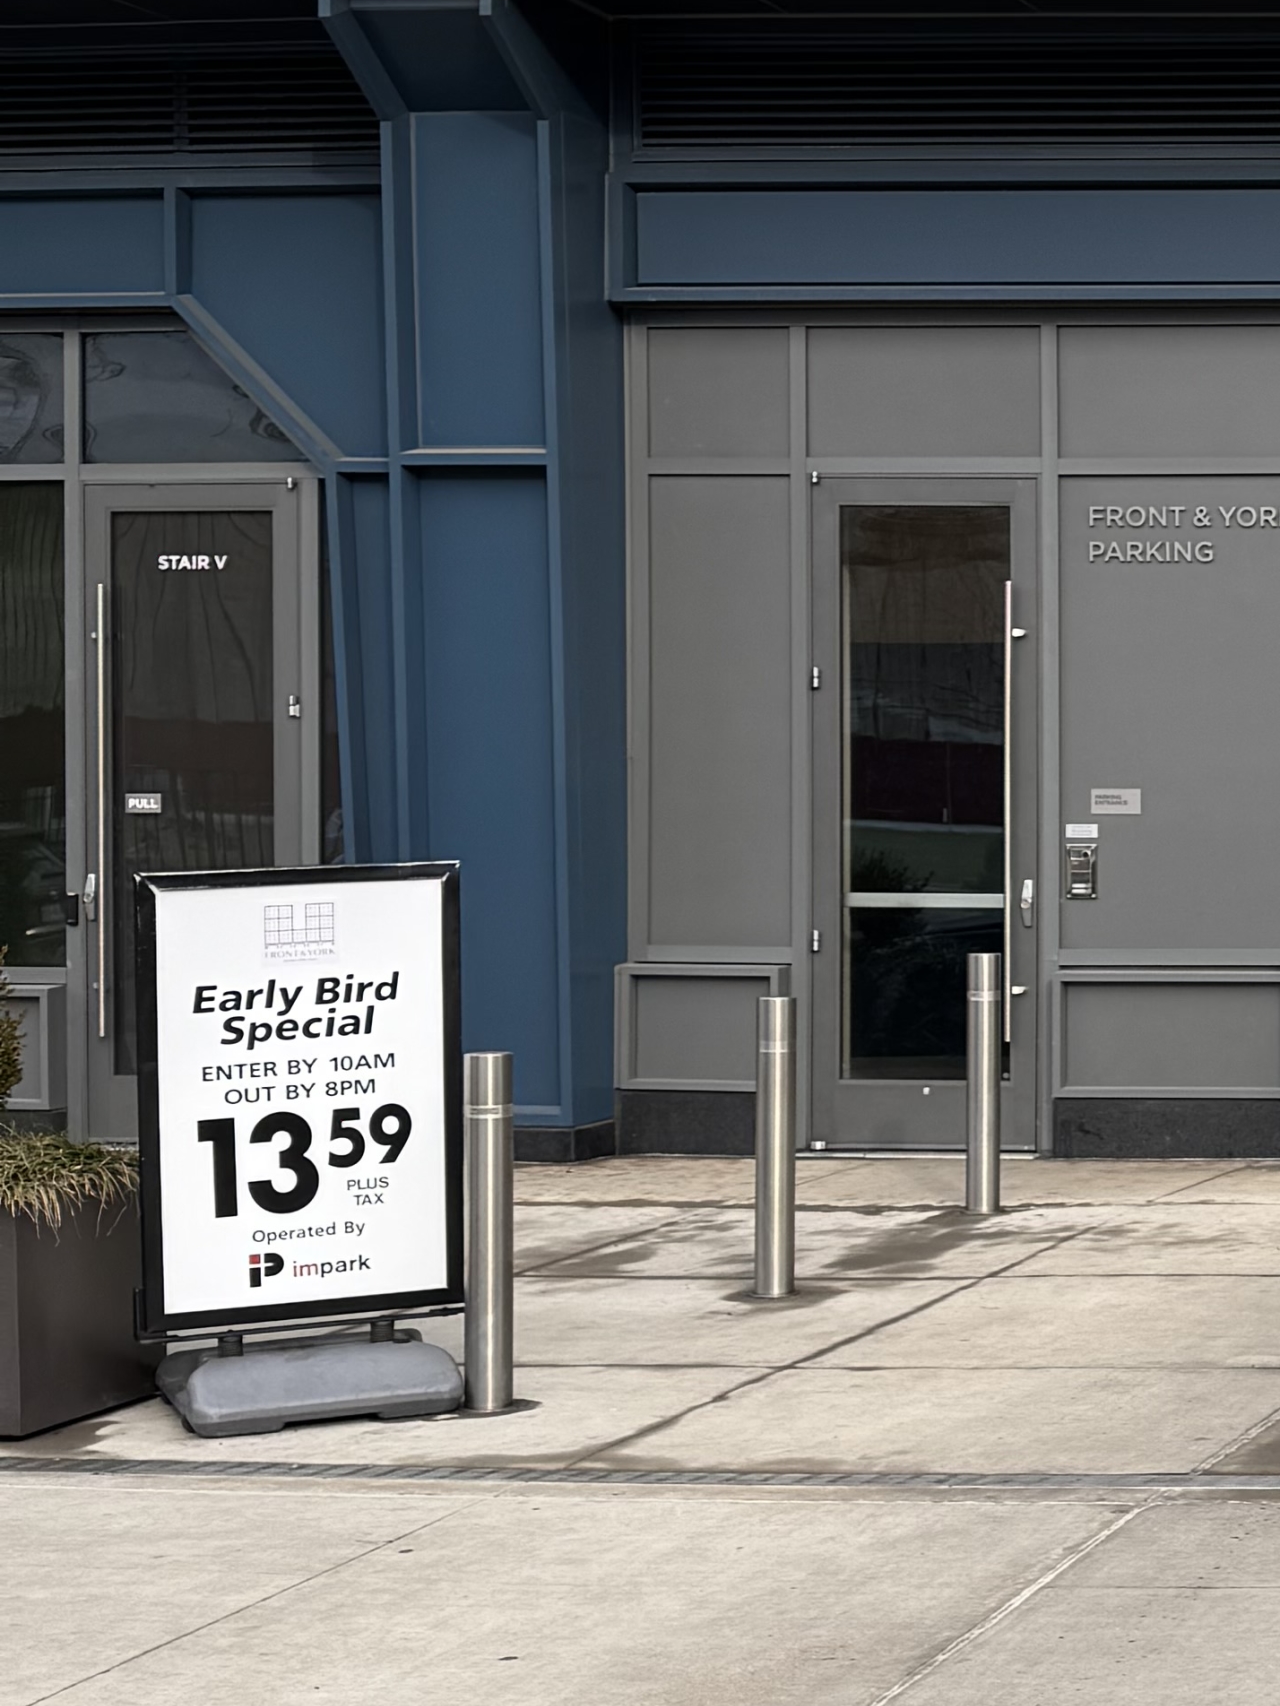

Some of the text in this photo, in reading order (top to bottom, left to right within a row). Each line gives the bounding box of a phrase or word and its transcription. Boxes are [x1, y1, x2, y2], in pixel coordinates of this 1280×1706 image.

[1089, 506, 1186, 527] FRONT
[1193, 506, 1212, 527] &
[158, 555, 228, 570] STAIR V
[1089, 541, 1214, 563] PARKING
[128, 798, 158, 809] PULL
[192, 971, 399, 1016] Early Bird
[220, 1005, 375, 1050] Special
[202, 1053, 395, 1082] ENTER BY 10AM
[224, 1079, 375, 1104] OUT BY 8PM
[346, 1176, 389, 1191] PLUS
[353, 1193, 385, 1206] TAX
[252, 1221, 366, 1244] Operated By
[293, 1255, 371, 1278] impark
